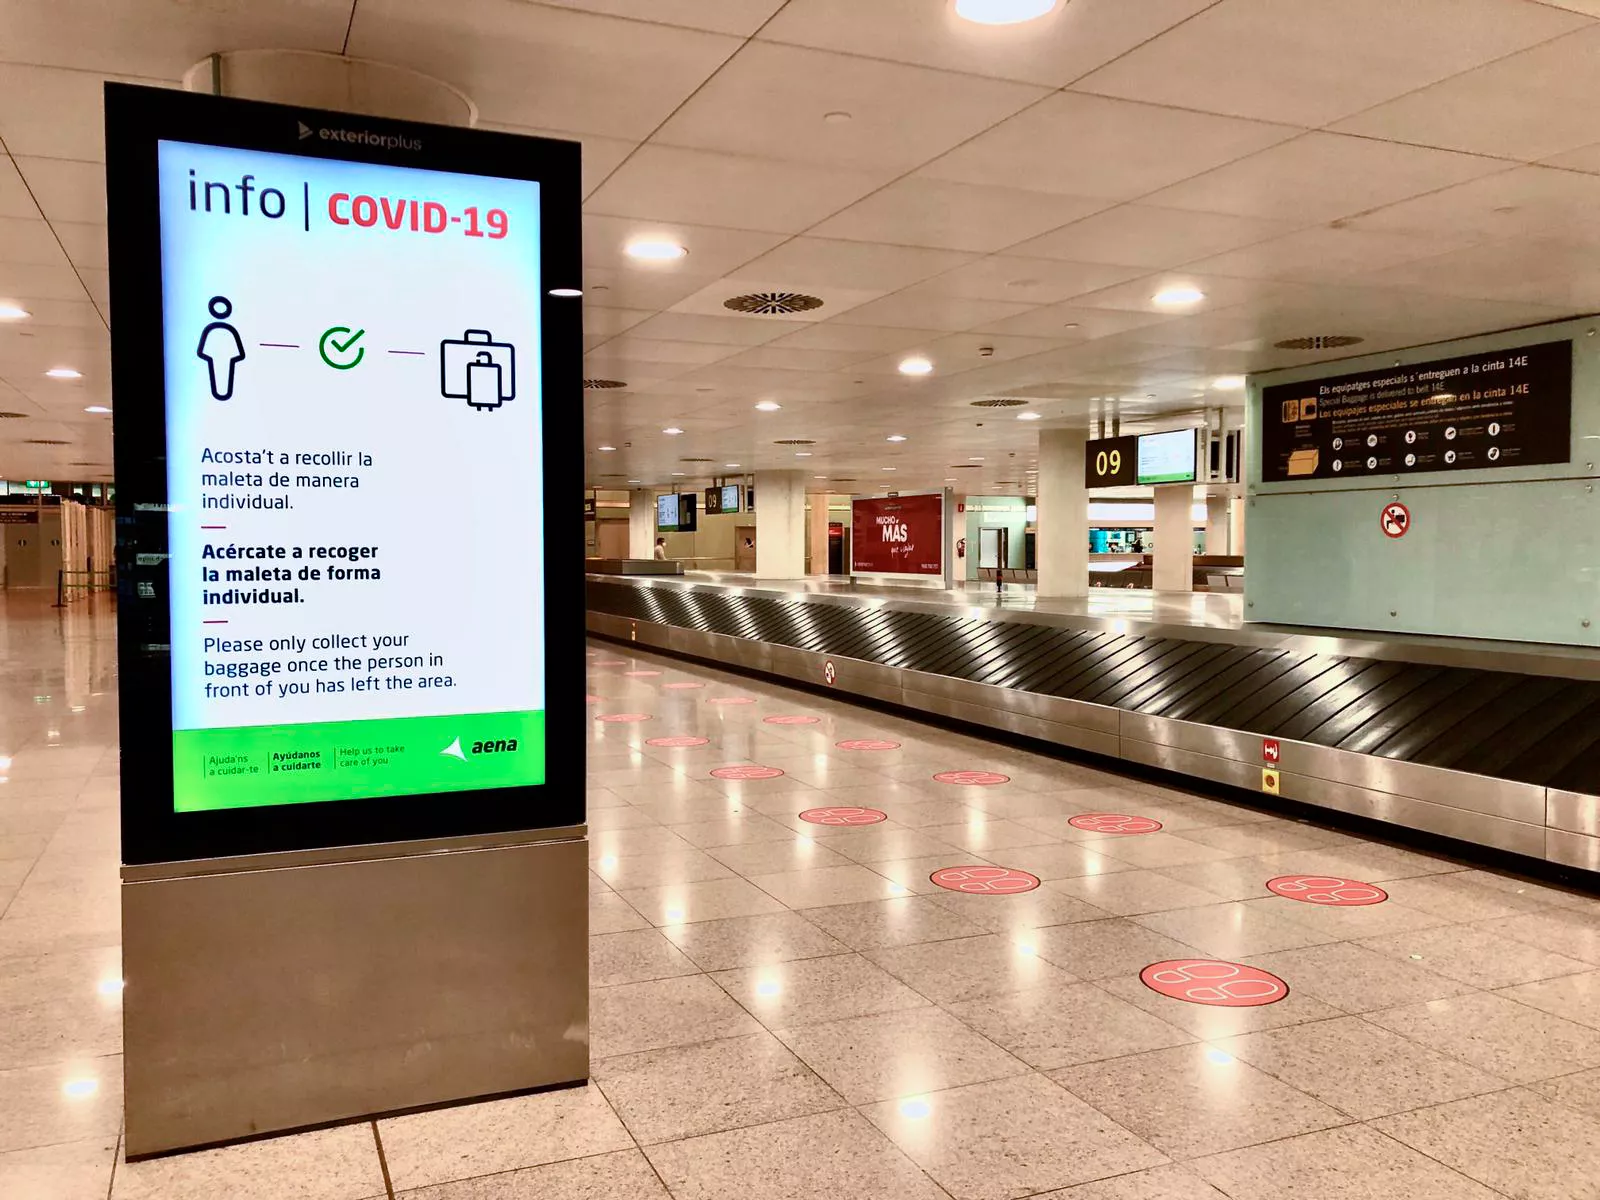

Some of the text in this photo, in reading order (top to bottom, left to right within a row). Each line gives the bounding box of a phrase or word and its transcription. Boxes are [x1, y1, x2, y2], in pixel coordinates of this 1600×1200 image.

[319, 127, 423, 151] exteriorplus
[190, 169, 507, 239] info COVID-19
[1320, 386, 1330, 395] Els
[1332, 381, 1370, 394] equipatges
[1373, 374, 1408, 387] especials
[1471, 364, 1479, 373] la
[1482, 360, 1505, 371] cinta
[1509, 356, 1528, 367] 14E
[1319, 409, 1331, 418] Los
[1333, 403, 1367, 417] equipajes
[1369, 398, 1407, 413] especiales
[1409, 399, 1419, 407] se
[1460, 392, 1470, 401] en
[1473, 390, 1481, 399] la
[1484, 388, 1506, 398] cinta
[1510, 383, 1529, 395] 14E
[202, 448, 372, 466] Acosta't a recollir la
[1096, 450, 1121, 476] 09
[203, 472, 358, 488] maleta de manera
[203, 494, 293, 509] individual.
[709, 495, 716, 508] 09
[876, 516, 895, 524] MUCHO
[882, 519, 907, 542] MÁS
[202, 544, 378, 561] Acércate a recoger
[203, 566, 380, 581] la maleta de forma
[204, 588, 304, 604] individual.
[205, 634, 408, 653] Please only collect your
[205, 653, 442, 678] baggage once the person in
[205, 676, 456, 698] front of you has left the area.
[340, 748, 360, 756] Help
[386, 745, 405, 753] take
[471, 737, 518, 755] aena
[209, 755, 248, 766] Ajuda'ns
[273, 751, 320, 762] Ayúdanos
[372, 757, 388, 766] you
[218, 766, 259, 775] cuidar-te
[281, 761, 321, 771] cuidarte
